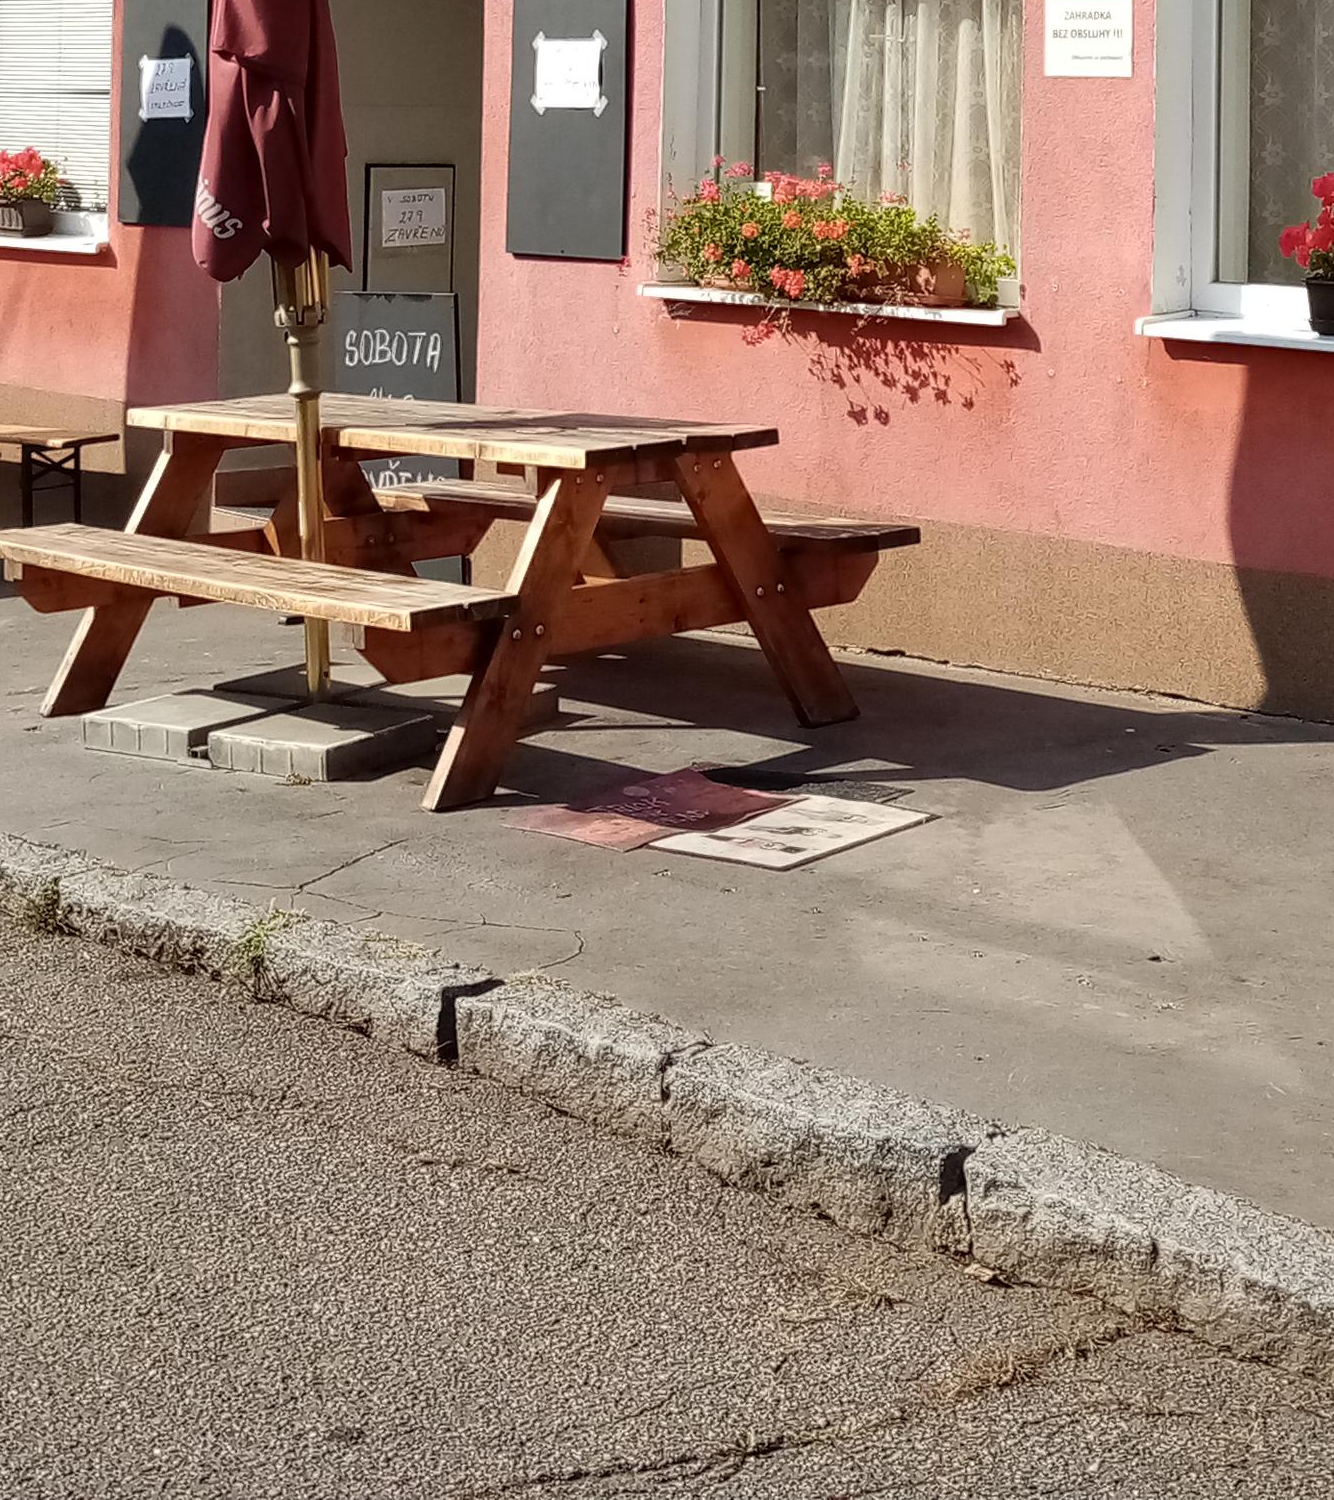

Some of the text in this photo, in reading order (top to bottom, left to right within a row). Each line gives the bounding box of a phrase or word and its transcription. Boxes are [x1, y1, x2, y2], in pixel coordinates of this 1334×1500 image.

[1052, 29, 1068, 38] BEZ
[1070, 29, 1110, 38] OBSLUHY
[345, 329, 442, 373] SOBOTA
